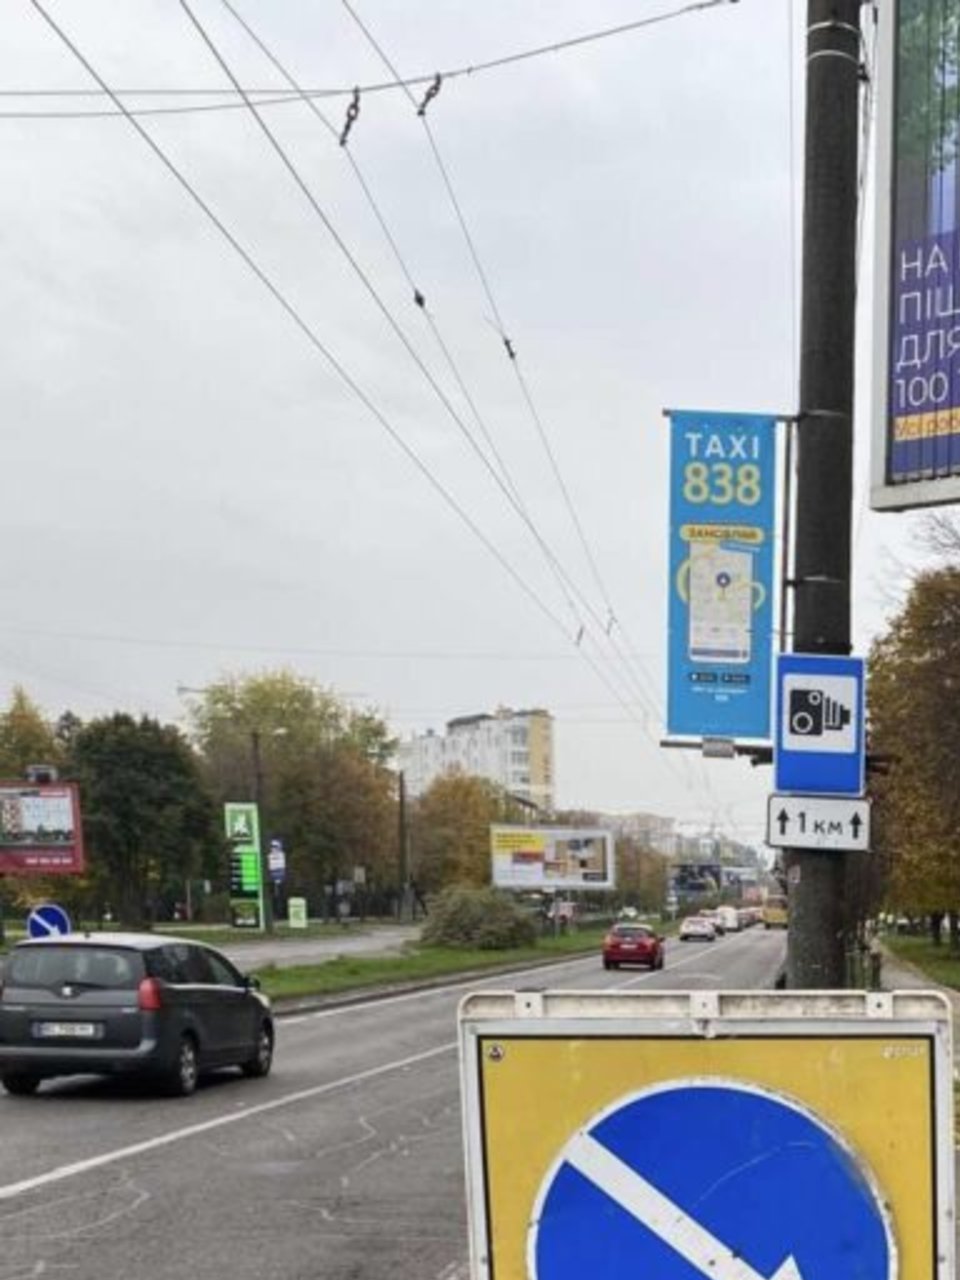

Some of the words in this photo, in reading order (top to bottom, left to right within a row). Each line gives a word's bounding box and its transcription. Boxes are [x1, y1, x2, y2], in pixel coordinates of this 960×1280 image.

[901, 245, 948, 282] НА
[896, 373, 949, 408] 100
[684, 432, 759, 458] TAXI
[683, 462, 761, 505] 838
[798, 812, 806, 834] 1
